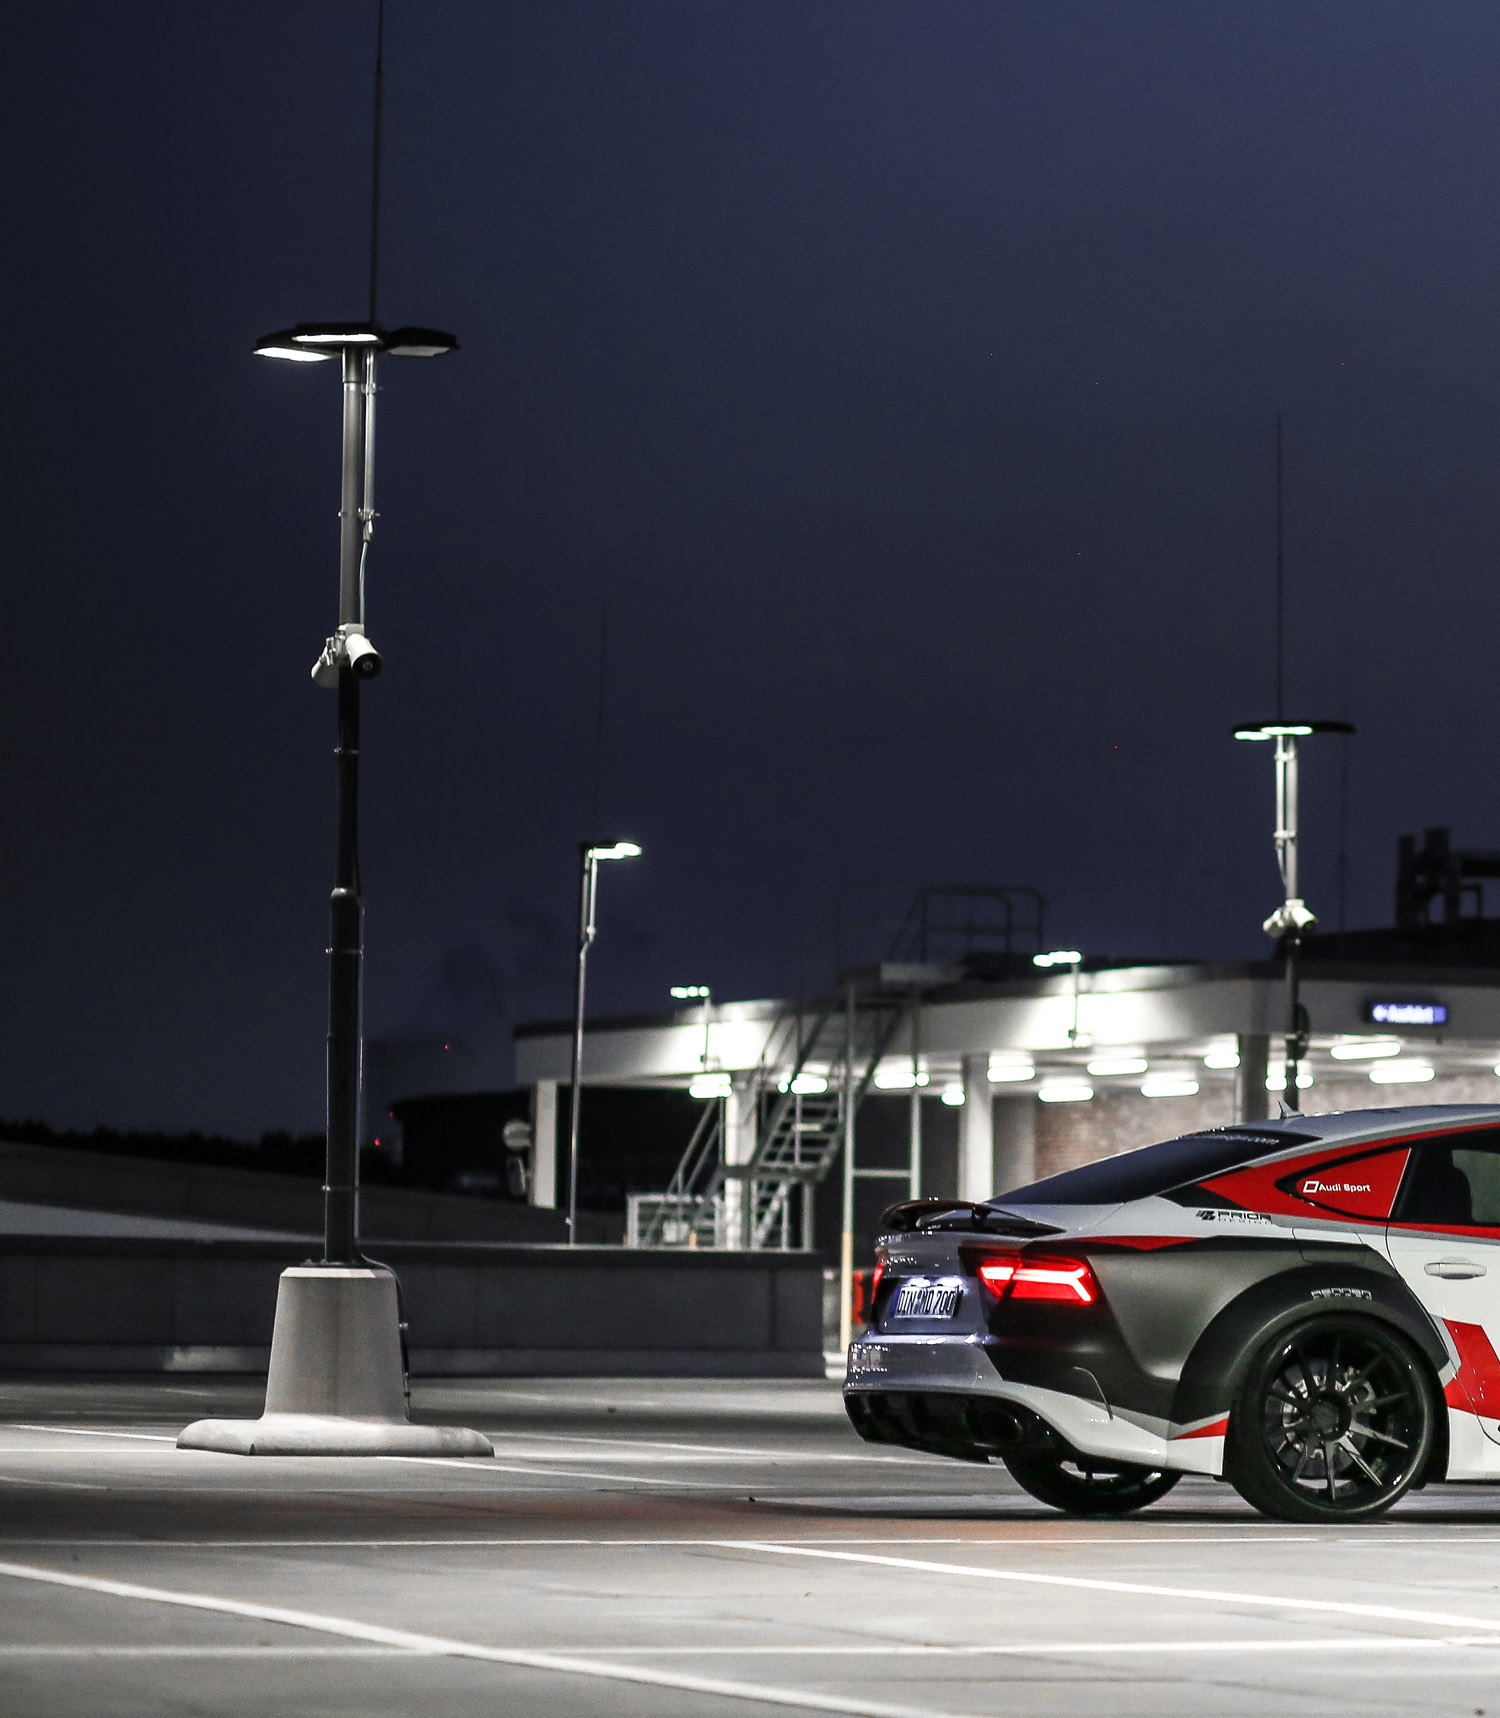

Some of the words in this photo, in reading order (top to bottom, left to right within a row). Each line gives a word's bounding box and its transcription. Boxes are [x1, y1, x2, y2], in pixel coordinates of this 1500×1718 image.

[1318, 1183, 1342, 1192] Audi
[1343, 1183, 1371, 1193] Sport
[1217, 1210, 1272, 1222] PRIOR
